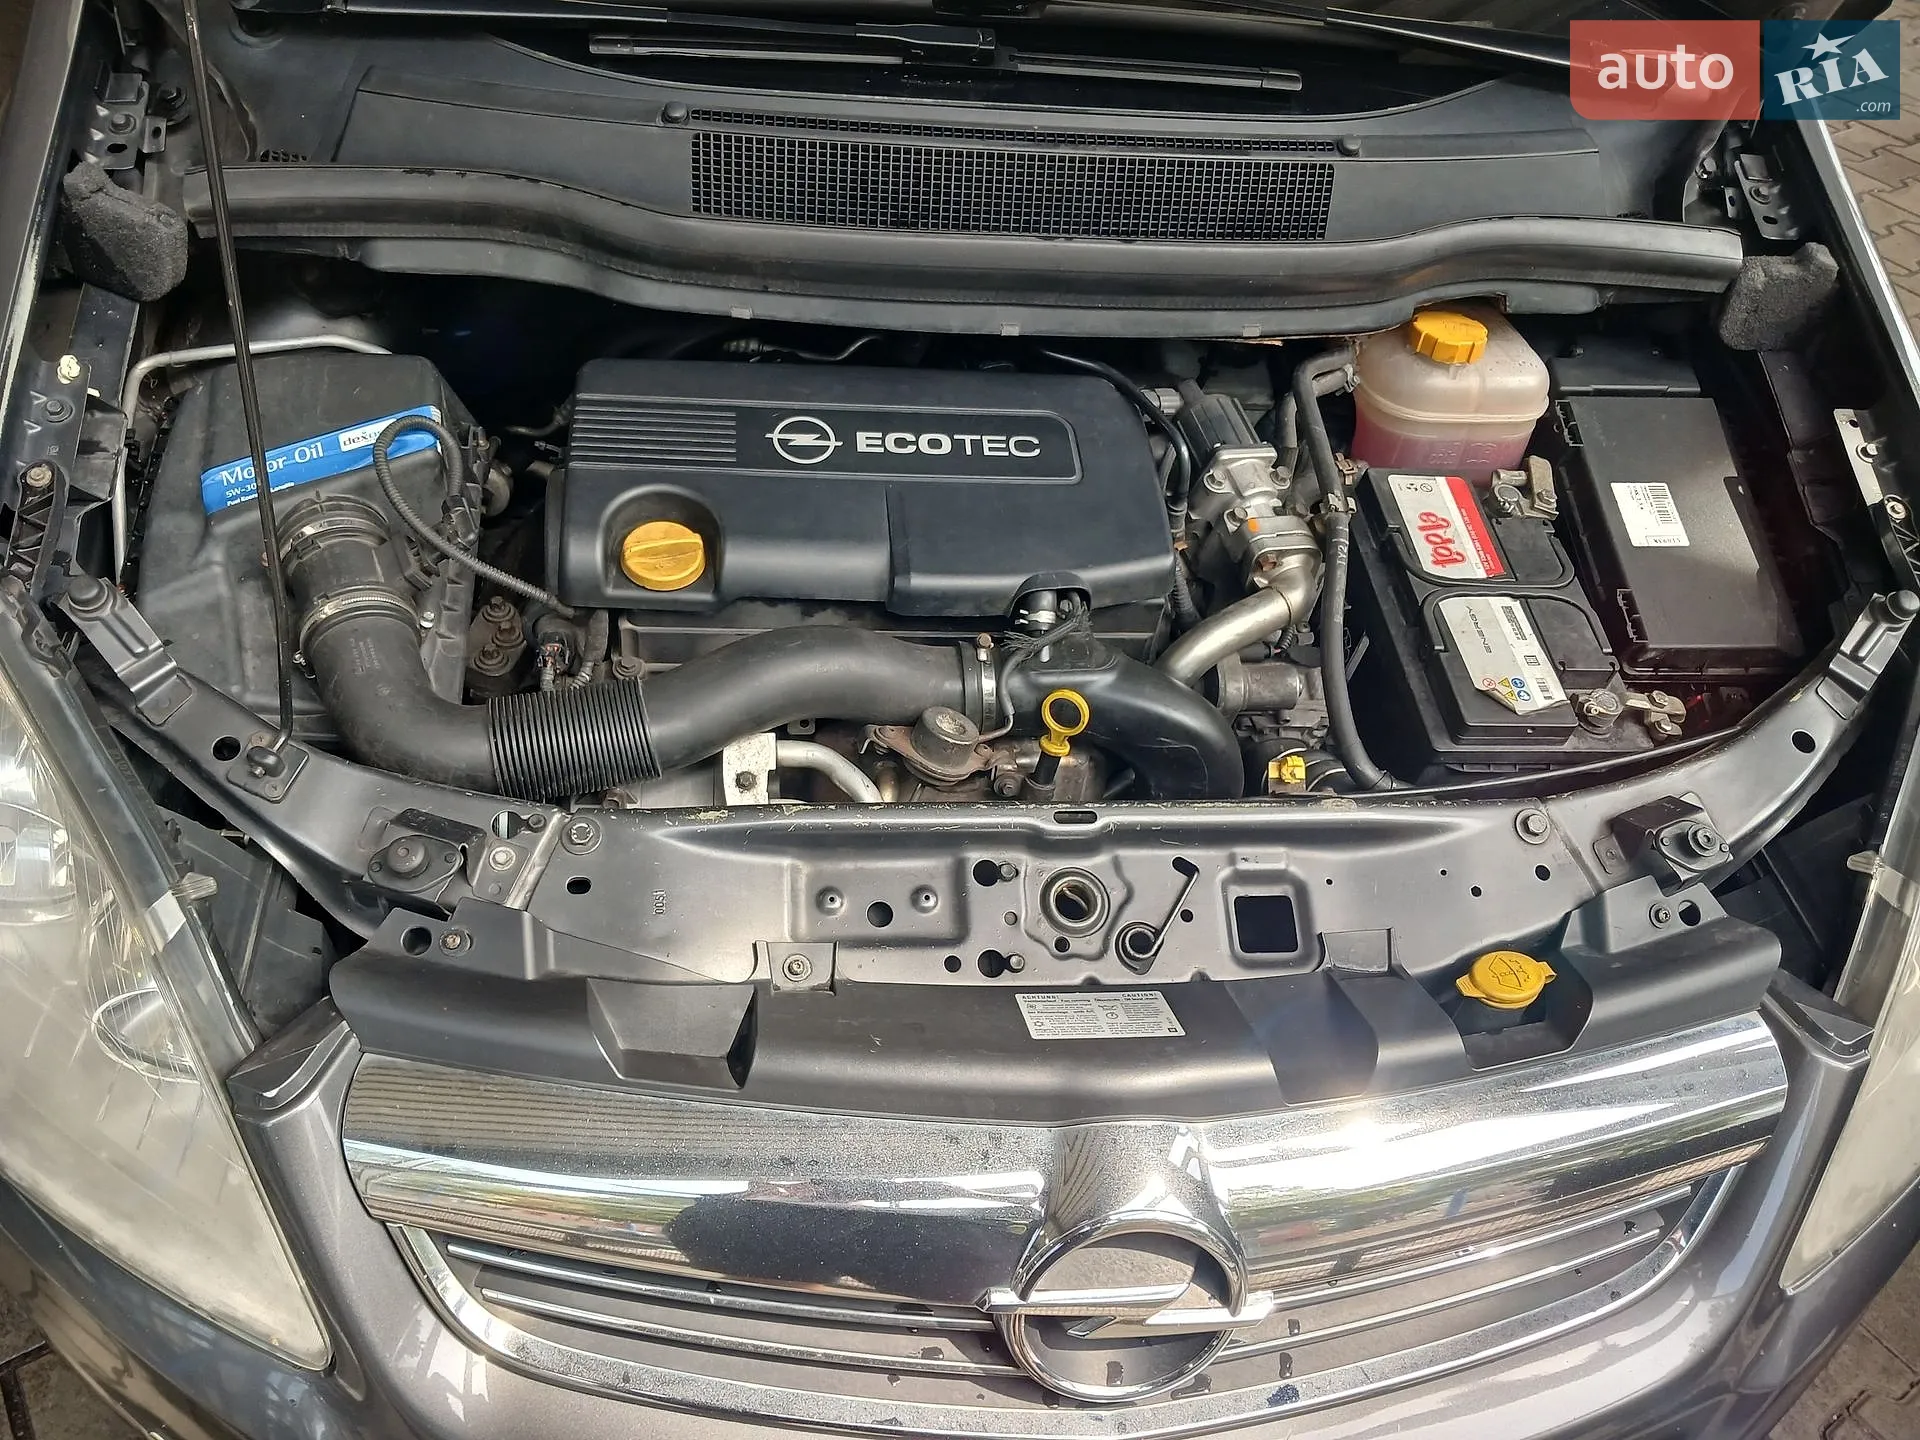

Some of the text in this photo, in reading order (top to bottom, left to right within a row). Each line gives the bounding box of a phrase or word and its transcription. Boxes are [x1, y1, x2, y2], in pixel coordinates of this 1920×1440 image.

[221, 442, 324, 486] Moor Oil
[856, 431, 1041, 458] ECOTEC
[226, 482, 257, 498] 5W-30
[1417, 511, 1466, 568] topla
[1465, 605, 1492, 654] ENERGY
